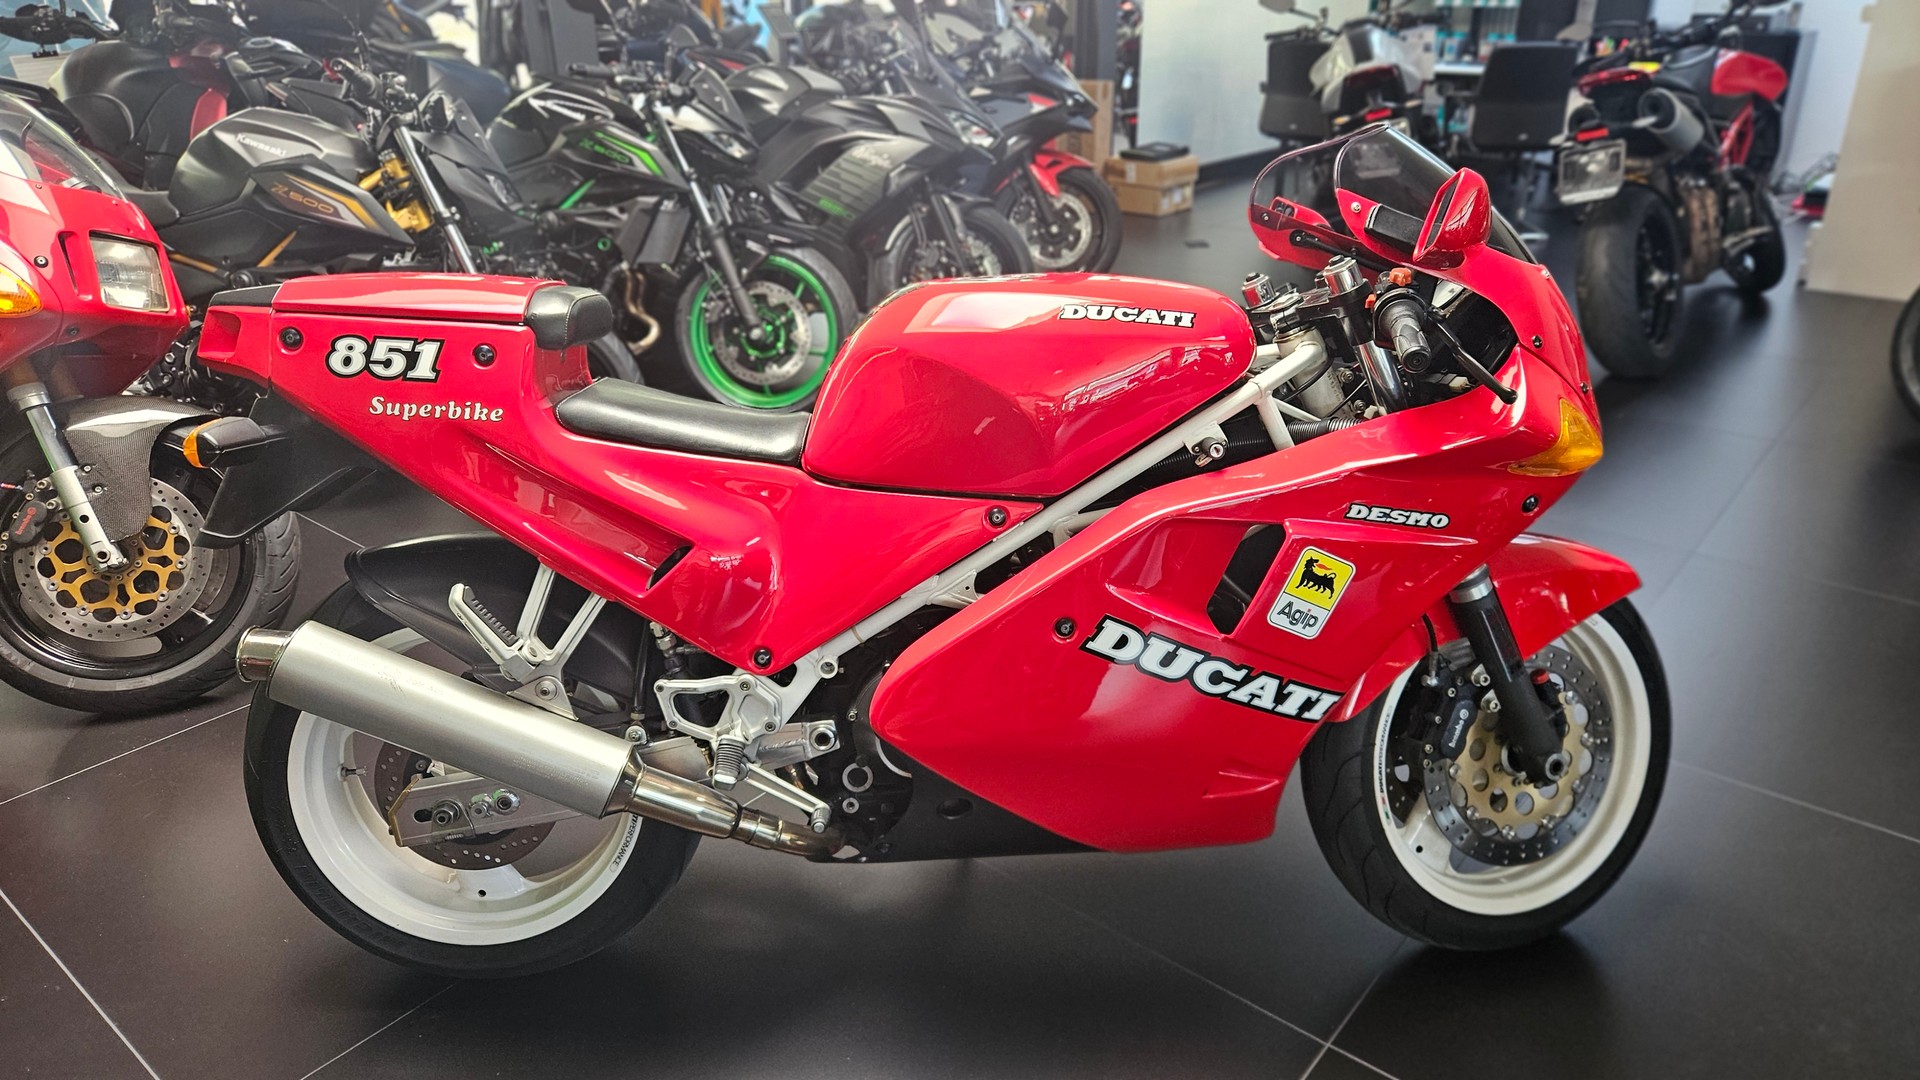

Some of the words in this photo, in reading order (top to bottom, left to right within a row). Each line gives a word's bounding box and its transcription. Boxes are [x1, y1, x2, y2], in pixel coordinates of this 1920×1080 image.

[237, 133, 287, 157] Kawasaki
[1058, 303, 1196, 328] DUCATI
[327, 336, 443, 382] 851
[369, 396, 504, 421] Superbike
[1345, 504, 1450, 529] DESMO
[1277, 600, 1319, 630] Agip
[1083, 617, 1342, 721] DUCATI
